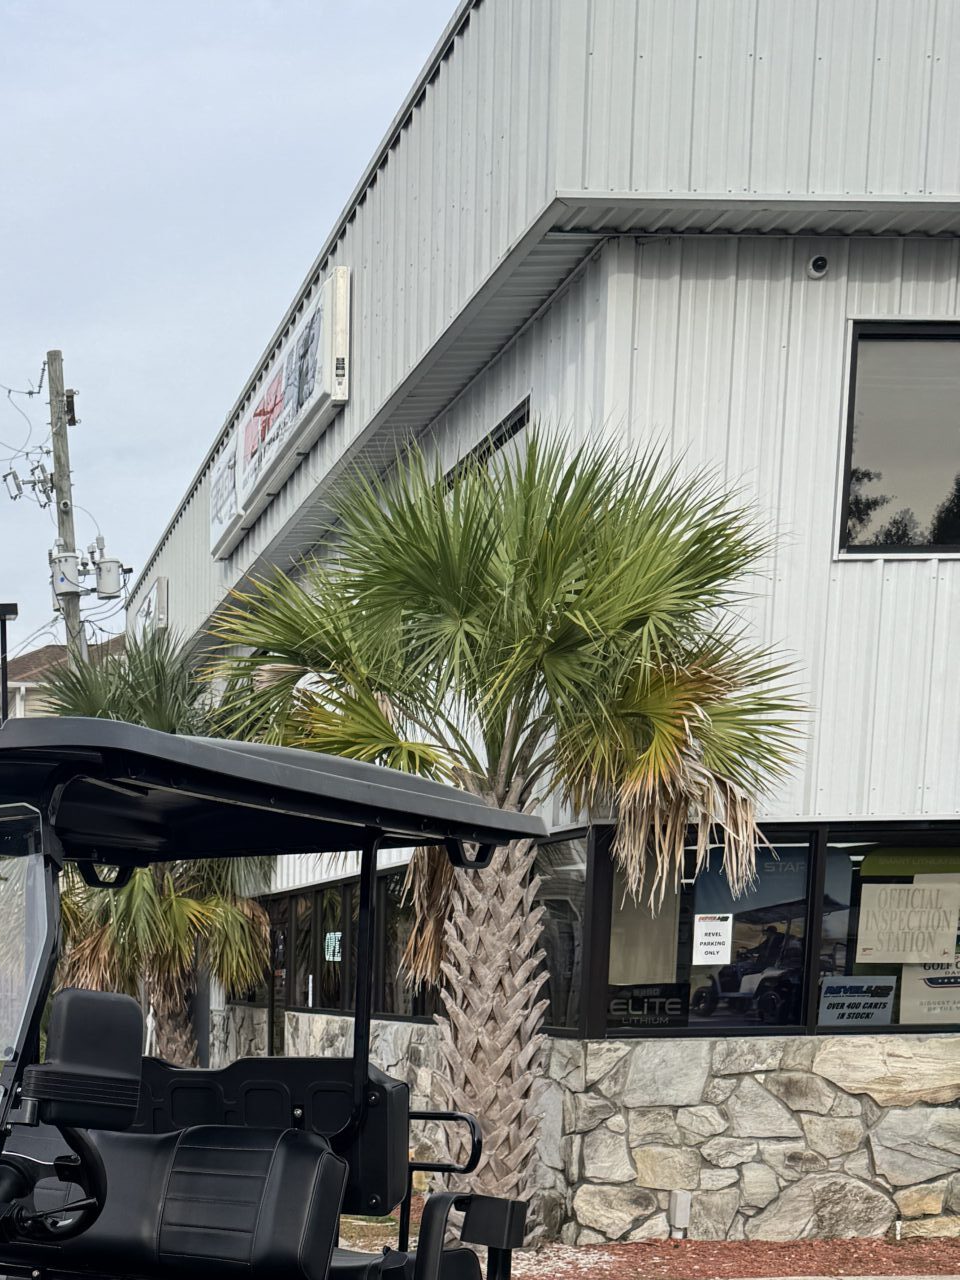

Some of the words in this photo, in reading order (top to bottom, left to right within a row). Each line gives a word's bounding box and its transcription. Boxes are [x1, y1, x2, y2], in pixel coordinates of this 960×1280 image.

[878, 887, 943, 910] OFFICIAL
[865, 909, 952, 931] INSPECTION
[876, 931, 937, 953] STATION
[826, 1002, 845, 1010] OVER
[862, 1002, 888, 1010] CARTS
[621, 1016, 669, 1025] LITHIUM
[846, 1012, 875, 1020] STOCK!
